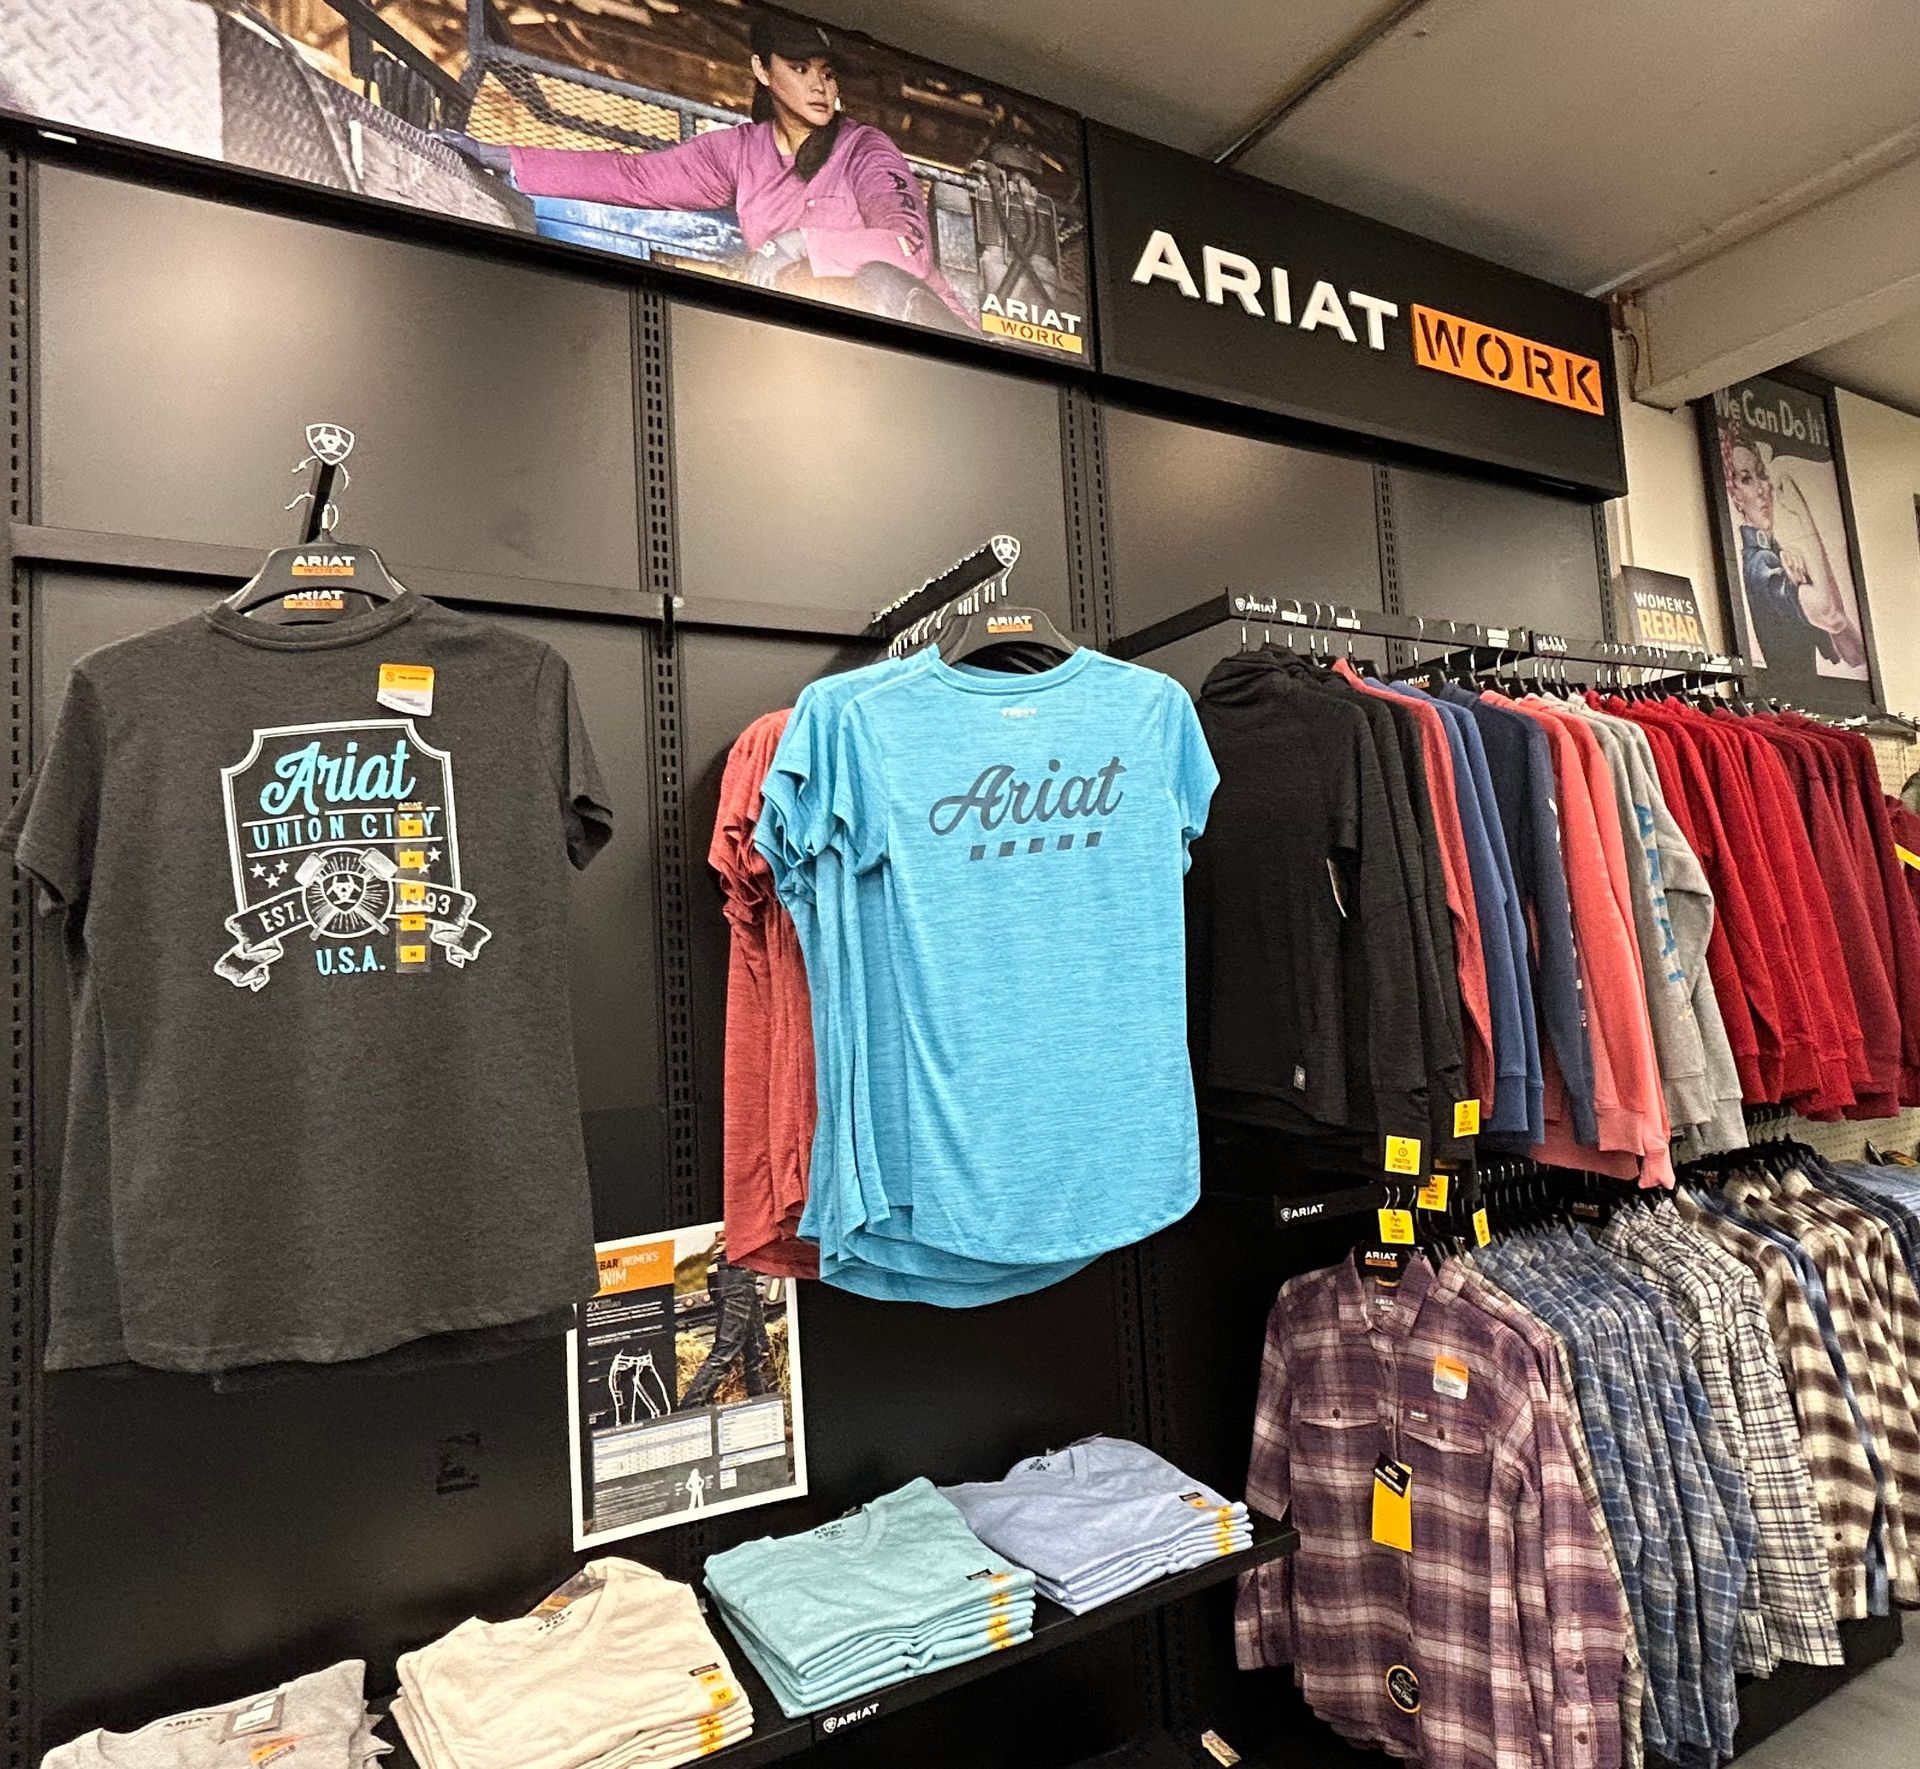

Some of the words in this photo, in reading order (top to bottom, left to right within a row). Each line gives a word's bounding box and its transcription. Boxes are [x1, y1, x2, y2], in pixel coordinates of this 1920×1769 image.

[981, 293, 1081, 334] ARIAT
[1131, 229, 1399, 351] ARIAT
[1417, 312, 1599, 408] WORK
[1000, 320, 1065, 348] WORK
[1742, 389, 1779, 433] Can
[1779, 399, 1806, 441] Do
[292, 555, 356, 567] ARIAT
[1634, 592, 1695, 615] WOMEN'S
[987, 615, 1032, 626] ARIAT
[1637, 608, 1704, 647] REBAR
[260, 739, 416, 815] Ariat
[929, 756, 1127, 836] Ariat
[252, 814, 345, 850] UNION
[258, 901, 302, 933] EST.
[315, 945, 386, 976] U.S.A.
[1291, 1203, 1324, 1219] ARIAT
[1364, 1250, 1398, 1261] ARIAT
[586, 1301, 601, 1313] 2X
[836, 1702, 880, 1728] ARIAT
